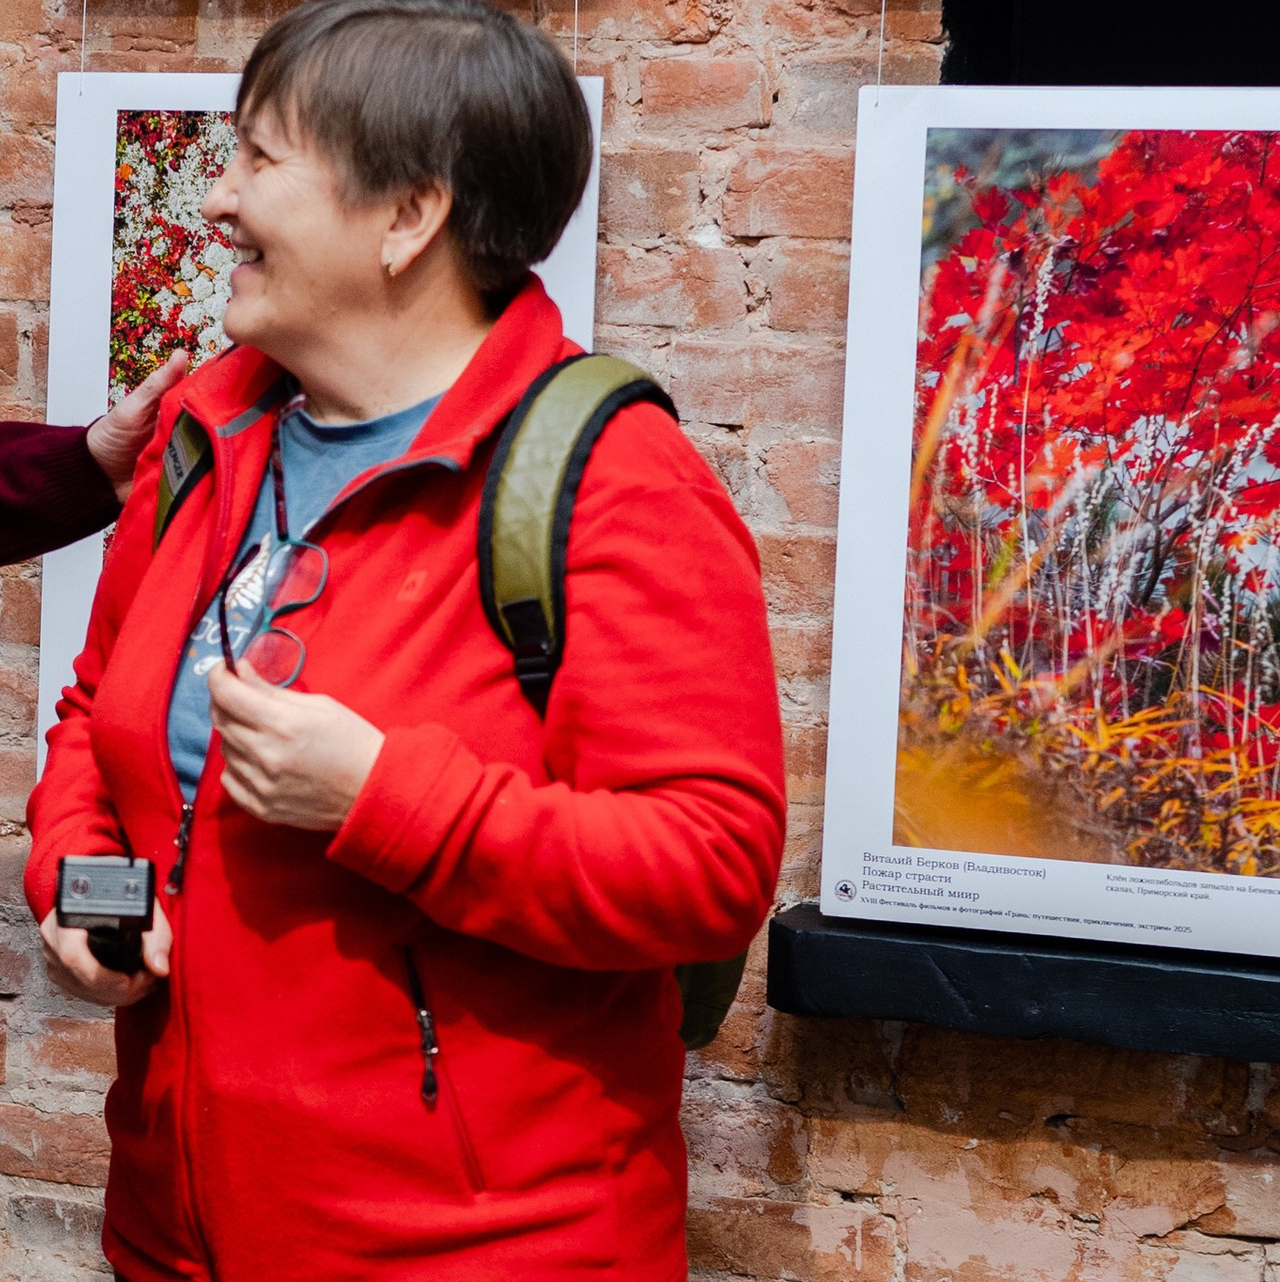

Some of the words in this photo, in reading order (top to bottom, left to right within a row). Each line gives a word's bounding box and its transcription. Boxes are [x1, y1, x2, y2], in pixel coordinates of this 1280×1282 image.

[862, 866, 902, 880] Пожар
[906, 872, 952, 884] страсти
[863, 852, 912, 866] Виталий
[916, 857, 960, 871] Берков
[963, 861, 1046, 879] (Владивосток)
[862, 880, 944, 897] Растительный
[948, 889, 980, 901] миир
[1106, 873, 1127, 883] Клён
[1199, 883, 1234, 891] запылал
[1236, 885, 1246, 893] на
[1136, 887, 1188, 899] Приморский
[860, 897, 877, 905] XVIII
[878, 899, 917, 909] Фестиваль
[918, 903, 950, 911] фильмов
[958, 906, 1003, 916] фотографий
[1174, 925, 1192, 933] 2025
